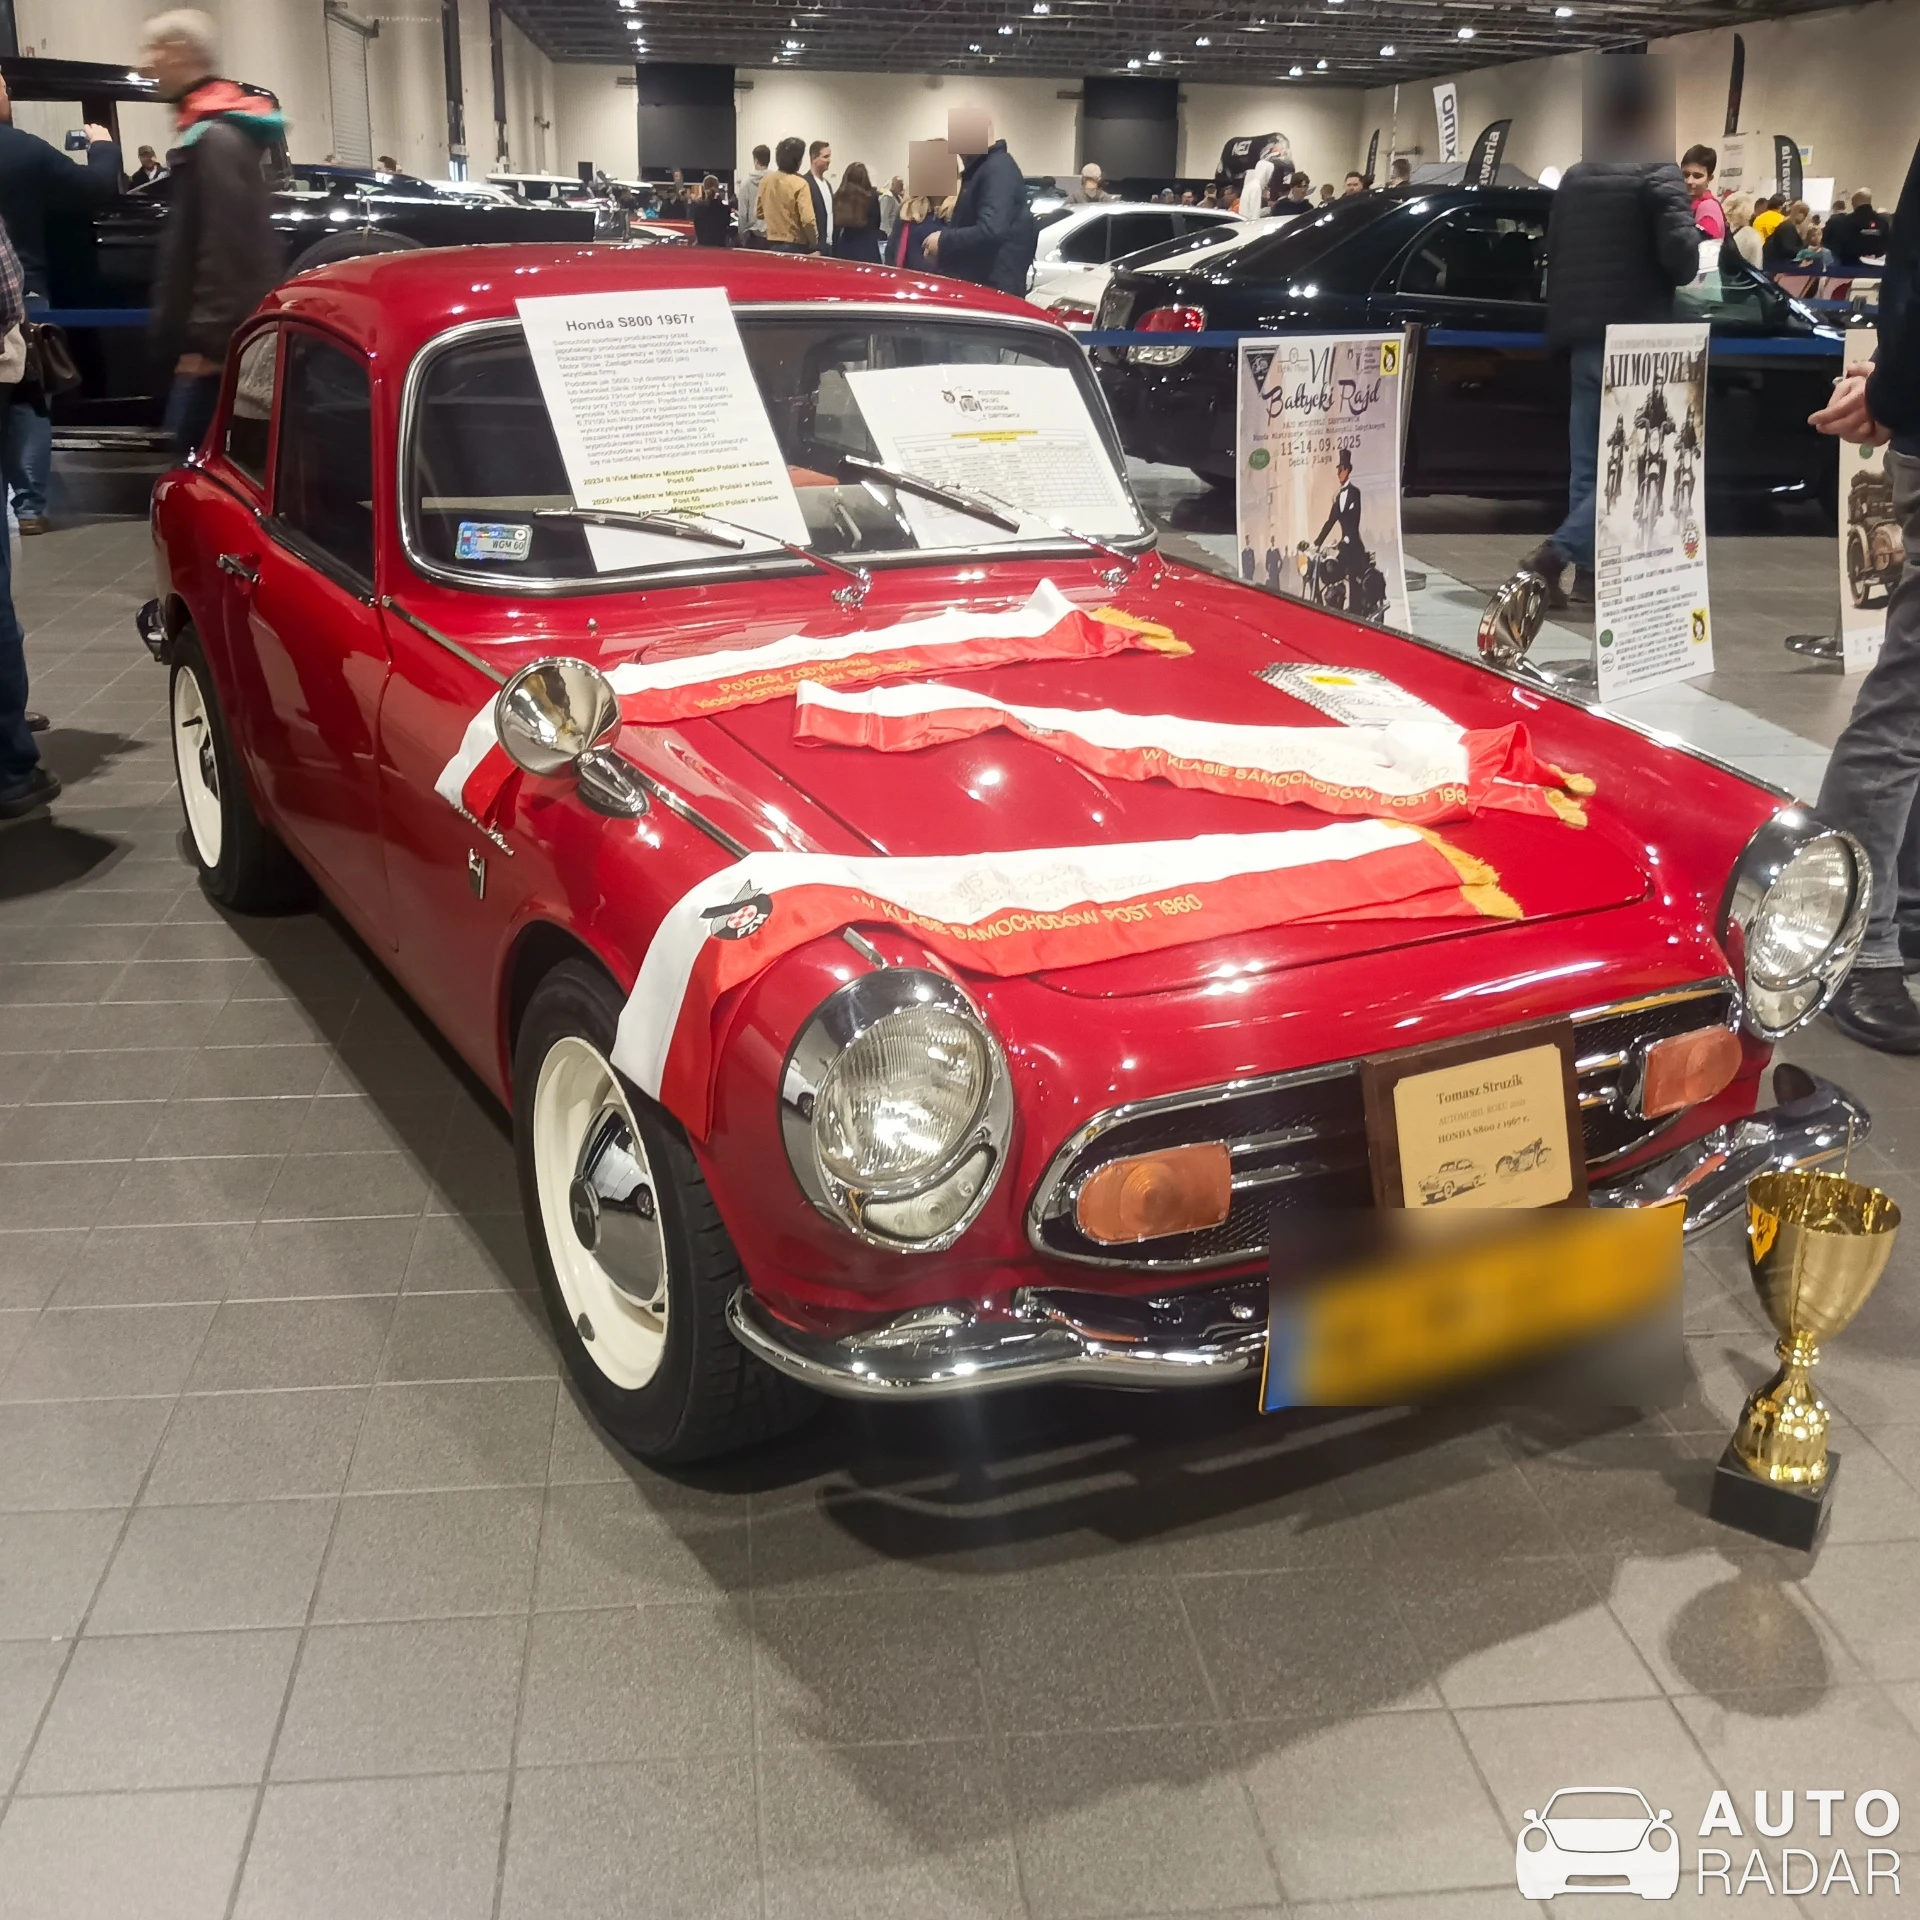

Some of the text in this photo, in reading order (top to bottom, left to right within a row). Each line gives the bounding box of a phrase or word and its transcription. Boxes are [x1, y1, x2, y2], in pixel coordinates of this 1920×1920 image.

[565, 313, 695, 332] Honda S800 1967r
[1309, 347, 1337, 384] VI
[1262, 378, 1382, 424] Bałtycki Rajd
[1281, 435, 1362, 456] 11-14.09.2025
[492, 541, 512, 549] WGM
[1142, 749, 1162, 761] W
[1167, 754, 1229, 778] KLASIE
[1234, 768, 1374, 800] SAMOCHODÓW
[1380, 792, 1430, 808] POST
[737, 913, 769, 938] PZM
[882, 902, 950, 936] KLASIE
[952, 908, 1099, 942] SAMOCHODÓW
[1101, 903, 1152, 923] POST
[1154, 893, 1203, 916] 1960
[1436, 1074, 1523, 1106] Tomasz Struzik
[1438, 1128, 1472, 1144] HONDA
[1473, 1124, 1495, 1135] S800
